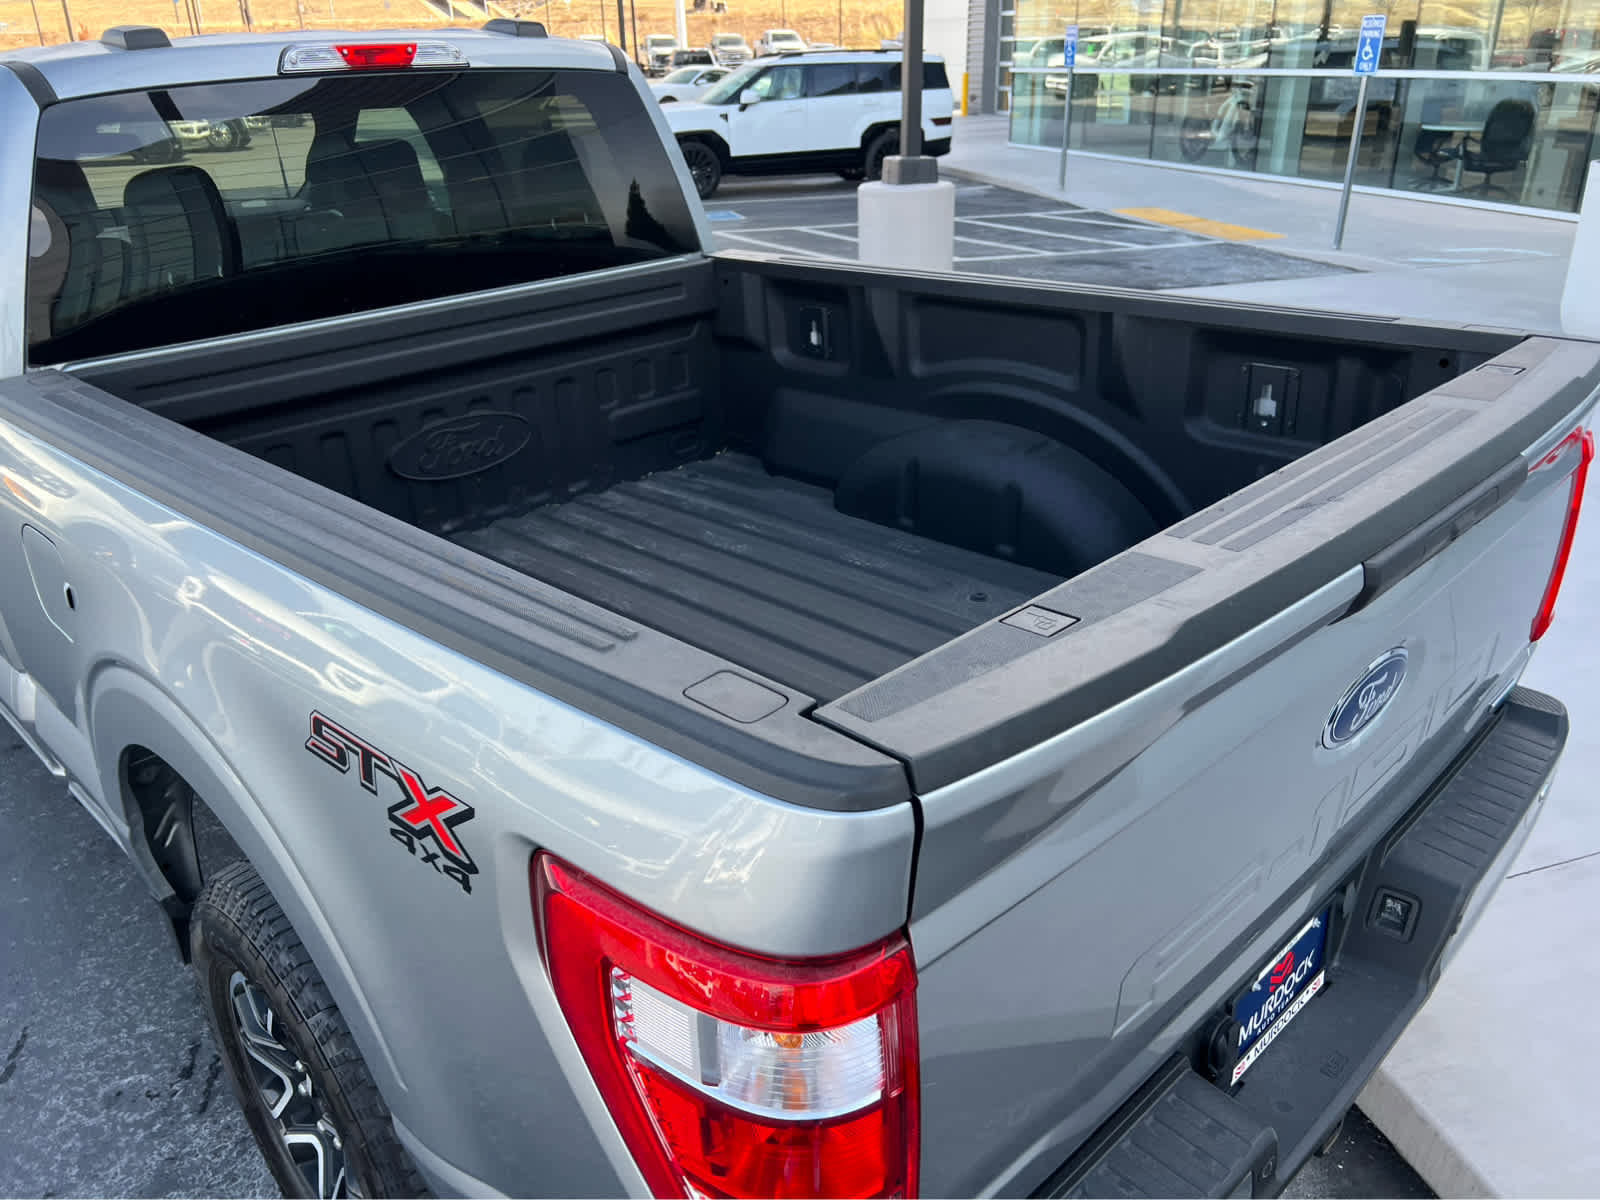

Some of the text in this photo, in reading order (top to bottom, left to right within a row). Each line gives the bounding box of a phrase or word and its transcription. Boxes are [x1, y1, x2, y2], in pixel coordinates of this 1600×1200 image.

[418, 421, 504, 470] Ford
[1349, 671, 1398, 732] Ford
[304, 709, 480, 875] STX
[1238, 948, 1316, 1047] MURDOCK
[1256, 990, 1295, 1036] AUTO TEAM
[1253, 998, 1306, 1058] MURDOCK
